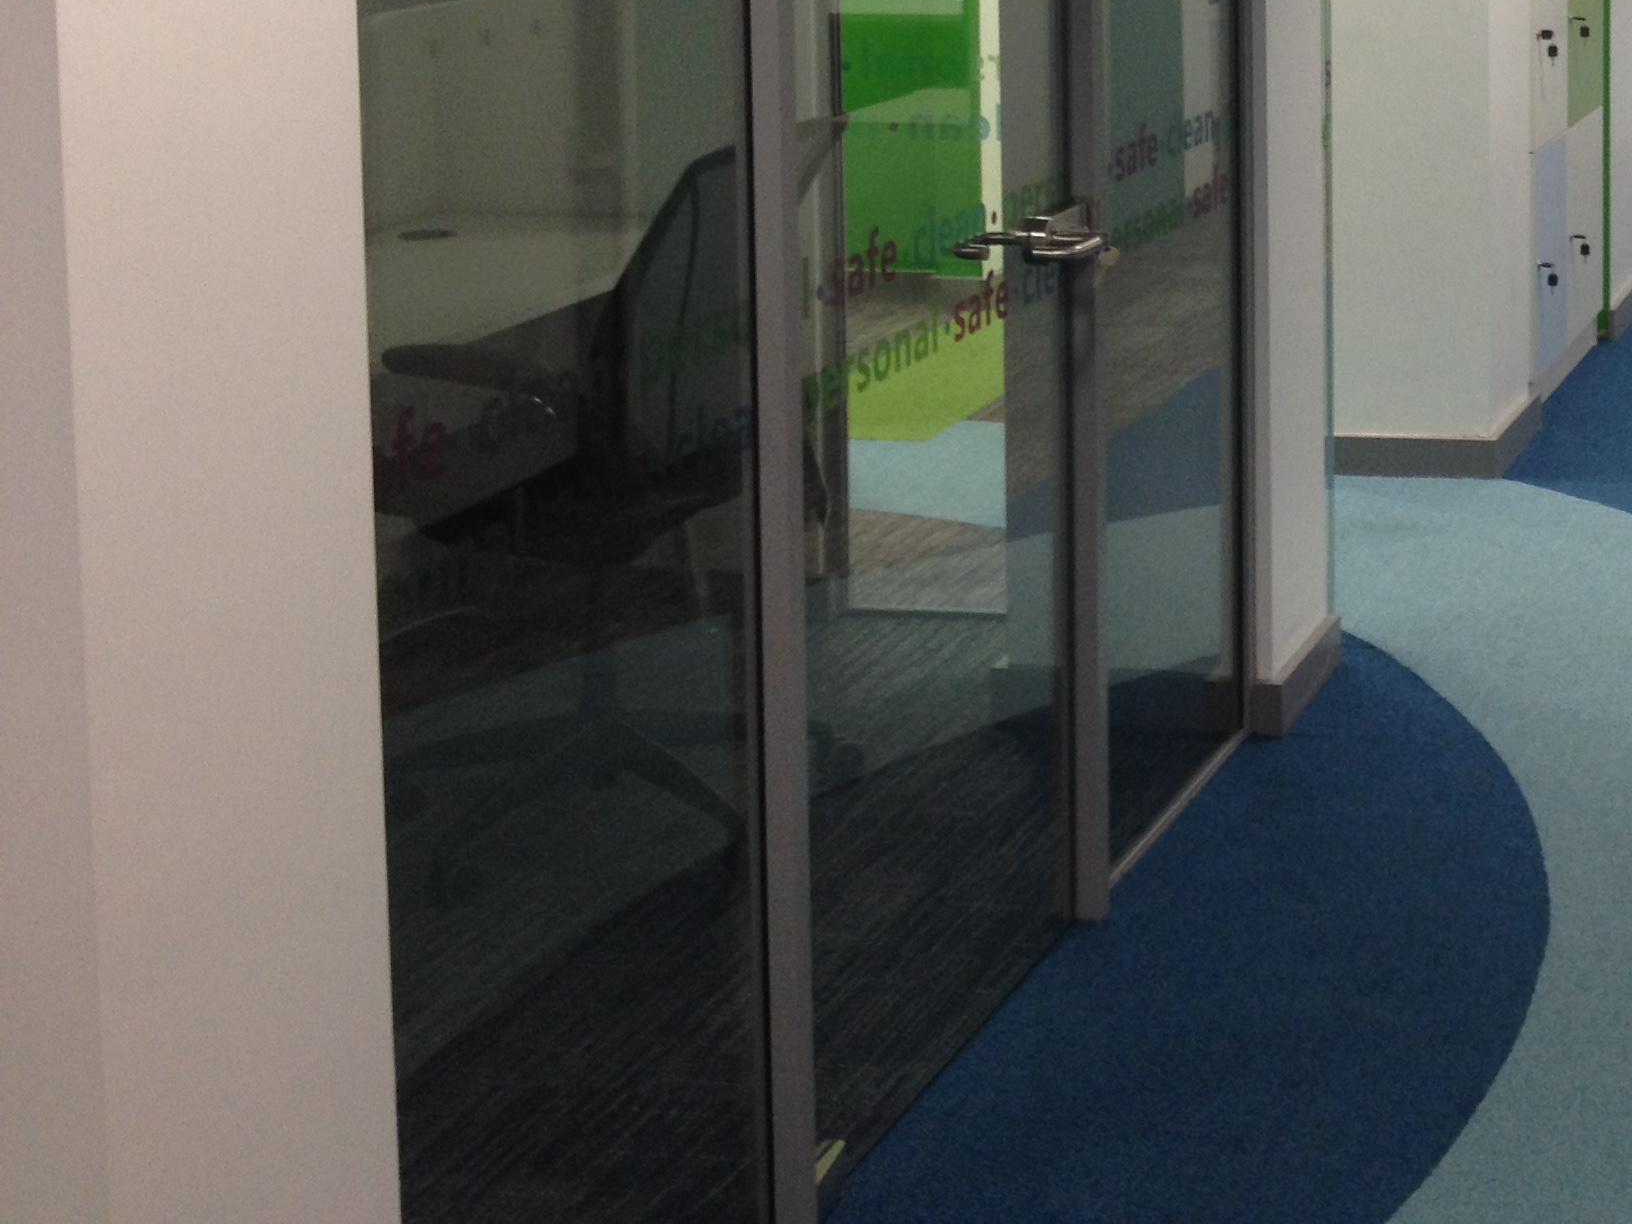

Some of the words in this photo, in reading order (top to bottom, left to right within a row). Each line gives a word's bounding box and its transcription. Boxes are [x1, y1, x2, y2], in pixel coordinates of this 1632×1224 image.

[1115, 123, 1158, 182] safe
[824, 226, 898, 306] safe
[953, 269, 1009, 343] safe
